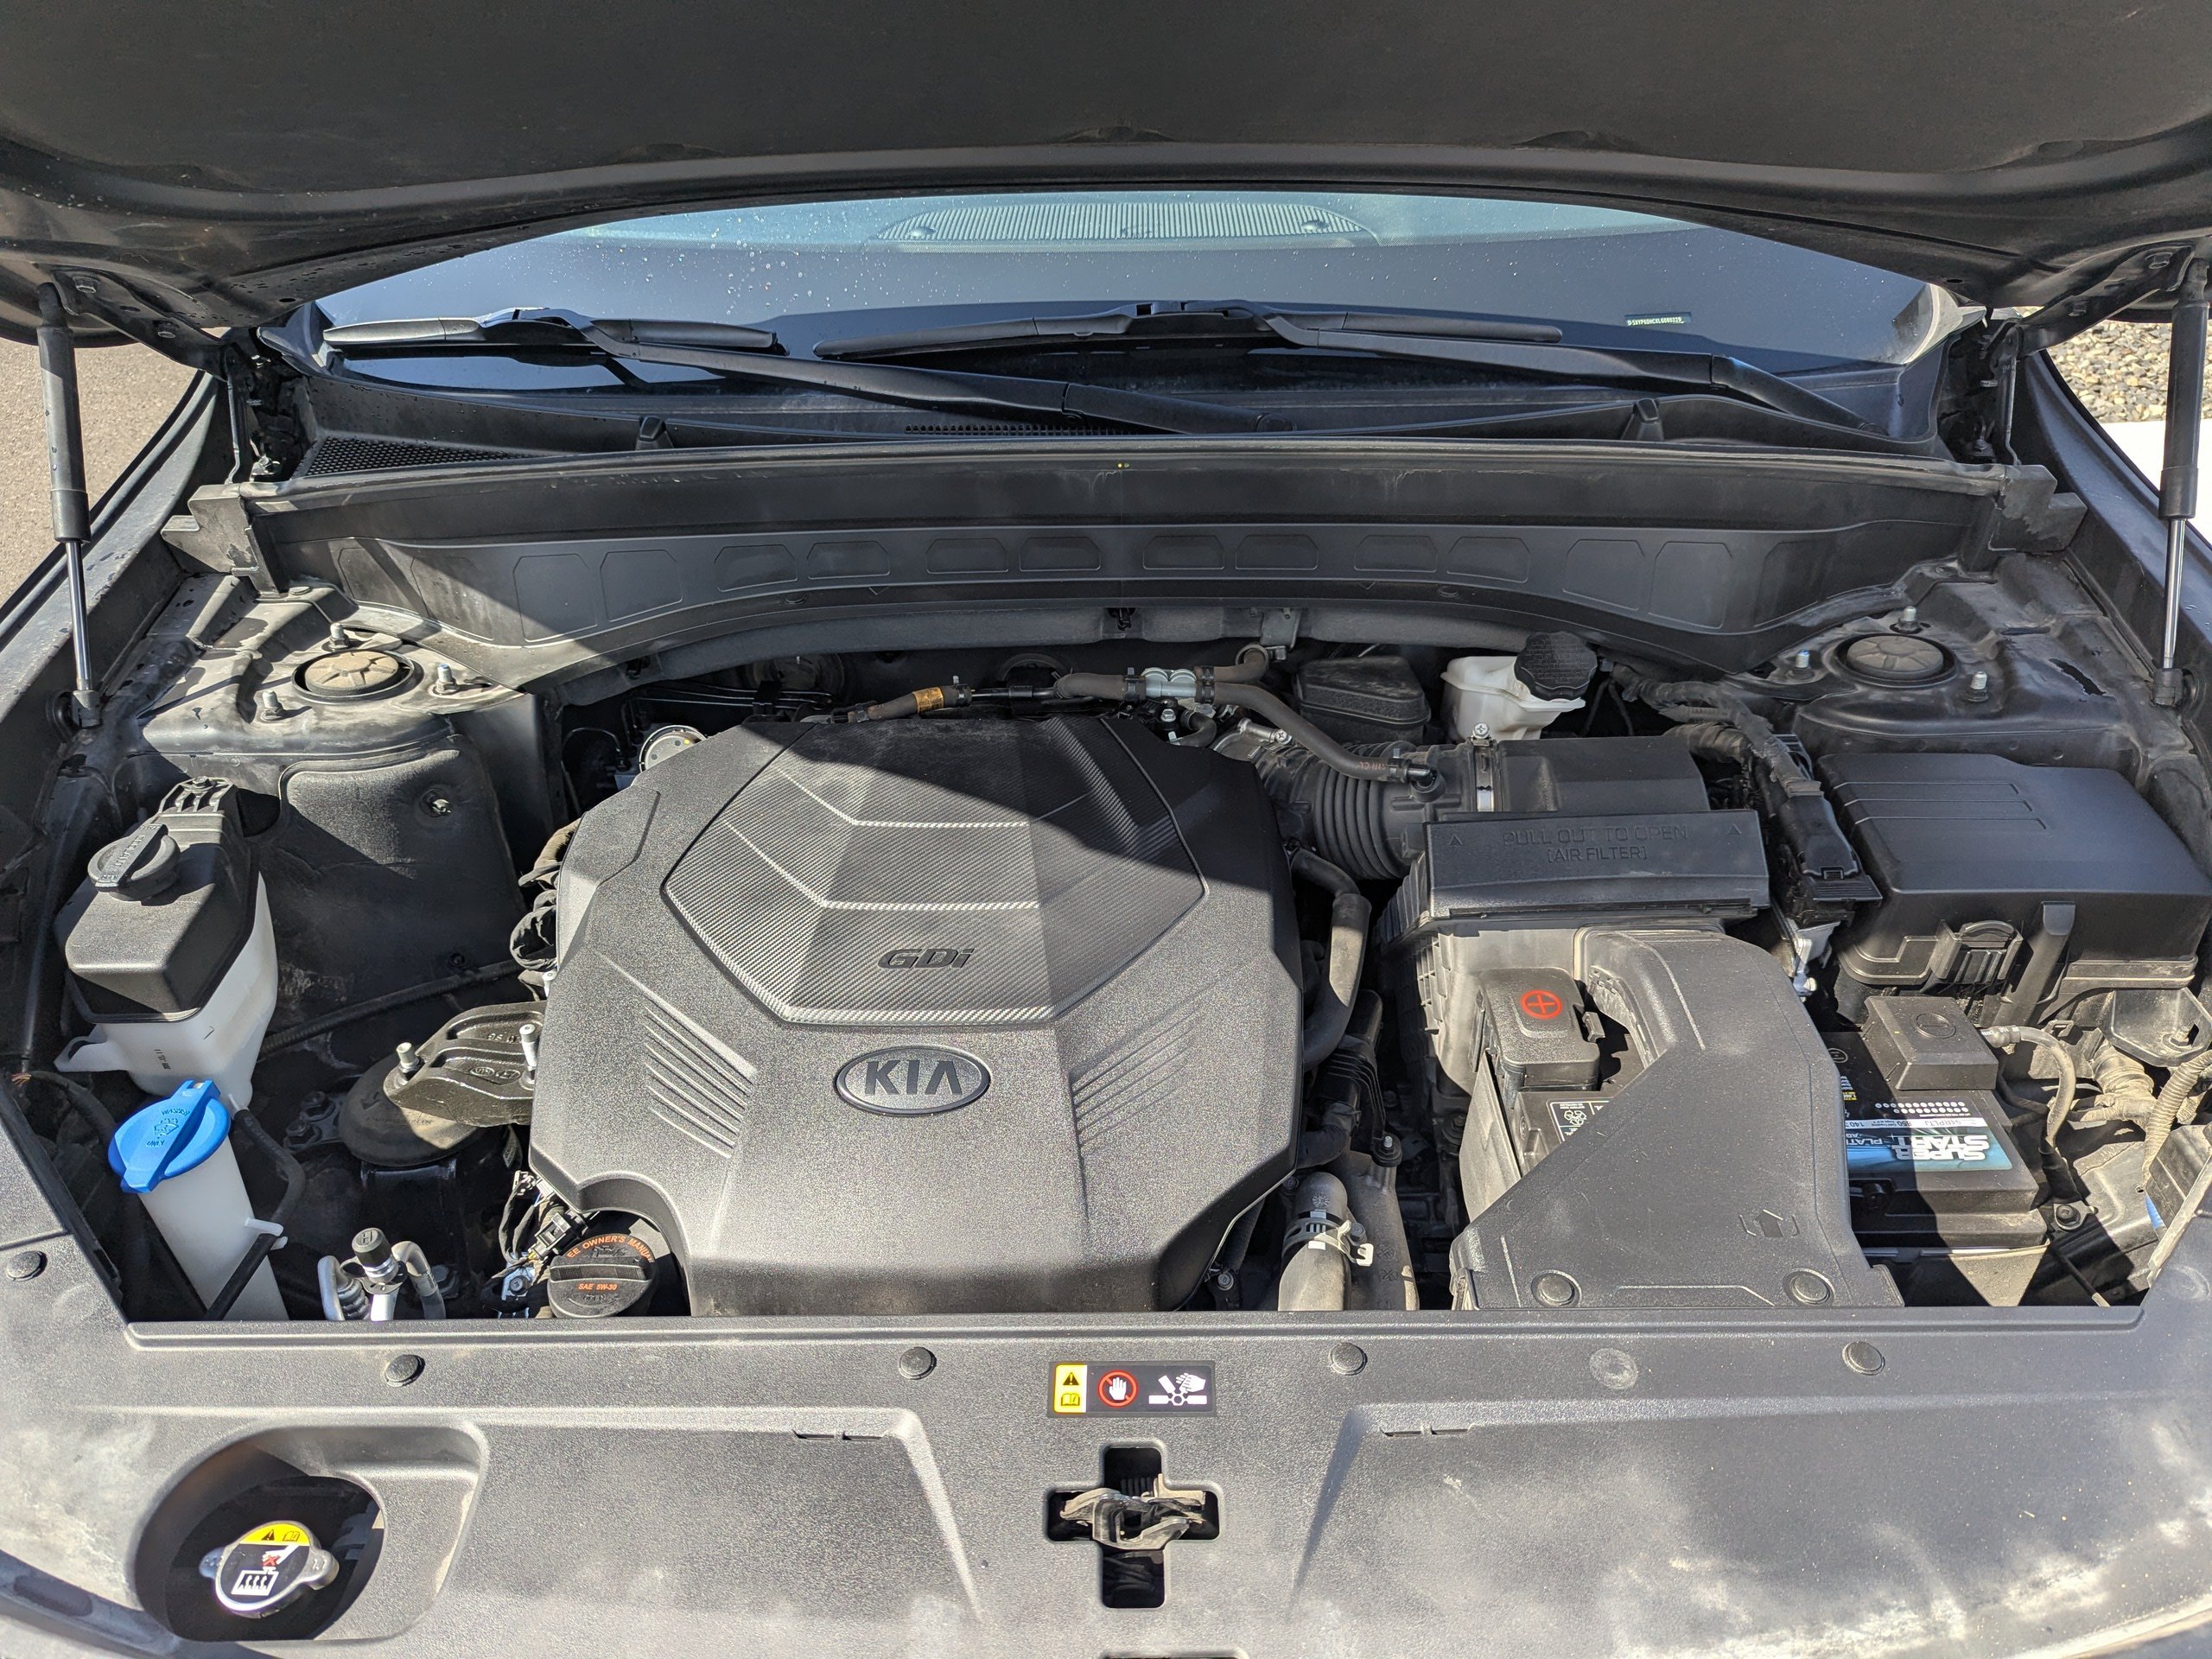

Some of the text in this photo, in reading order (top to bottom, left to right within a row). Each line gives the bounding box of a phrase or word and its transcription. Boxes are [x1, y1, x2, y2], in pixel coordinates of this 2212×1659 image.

[1503, 824, 1688, 846] PULL OUT TO OPEN
[877, 948, 975, 969] GDi
[864, 1060, 963, 1096] KIA
[1891, 1135, 1990, 1150] START
[1892, 1147, 1986, 1160] SUPER
[567, 1247, 581, 1258] EE
[582, 1235, 626, 1249] OWNER'S
